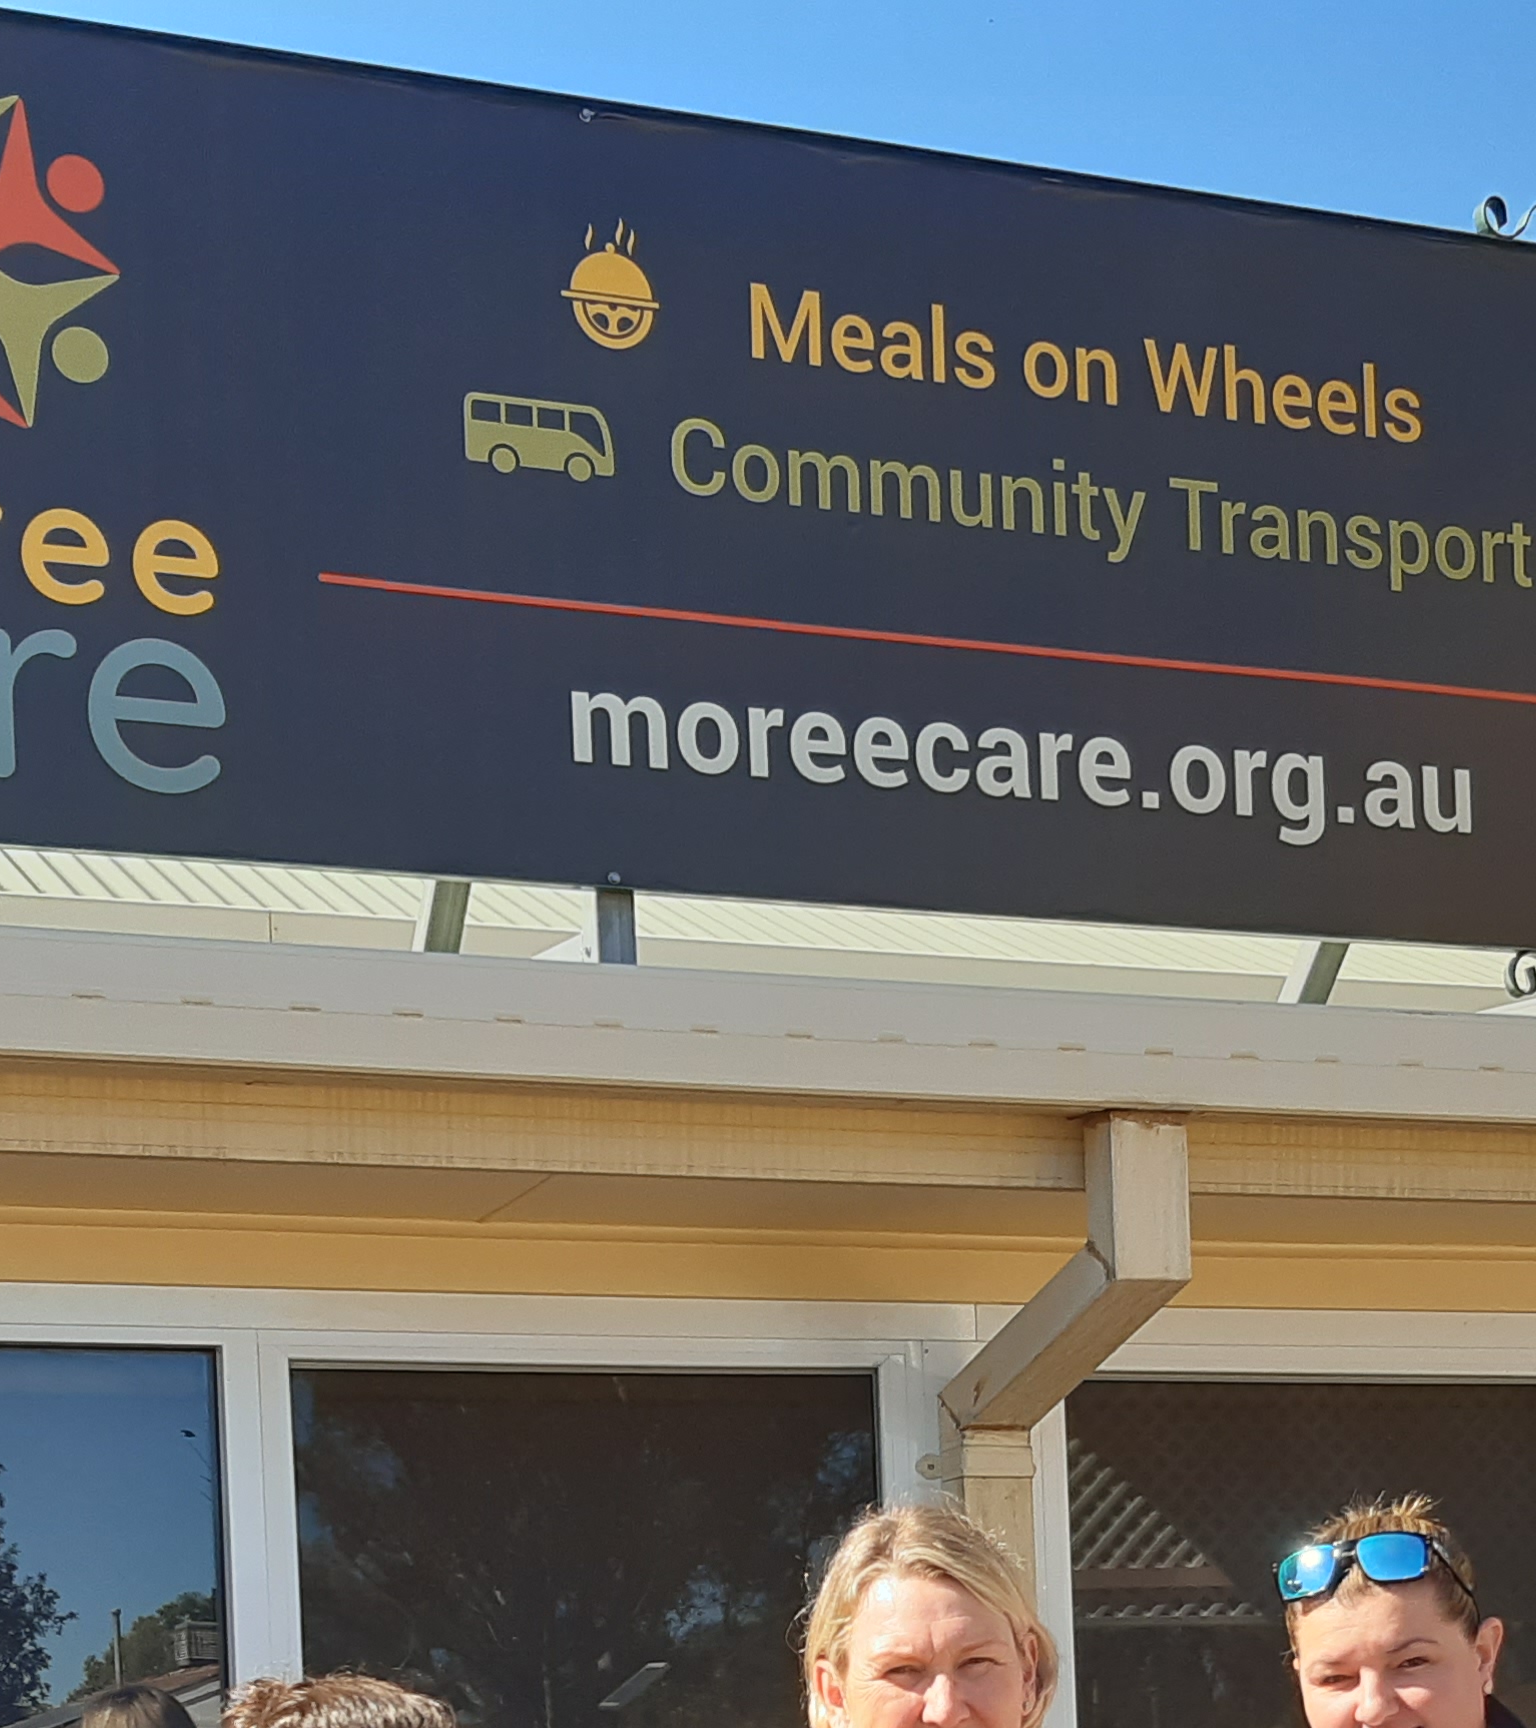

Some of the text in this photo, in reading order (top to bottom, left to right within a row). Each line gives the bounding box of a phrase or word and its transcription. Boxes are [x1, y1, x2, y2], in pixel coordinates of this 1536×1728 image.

[748, 282, 1424, 444] Meals on Wheels
[671, 417, 1533, 593] Community Transport
[570, 690, 1472, 846] moreecare.org.au
